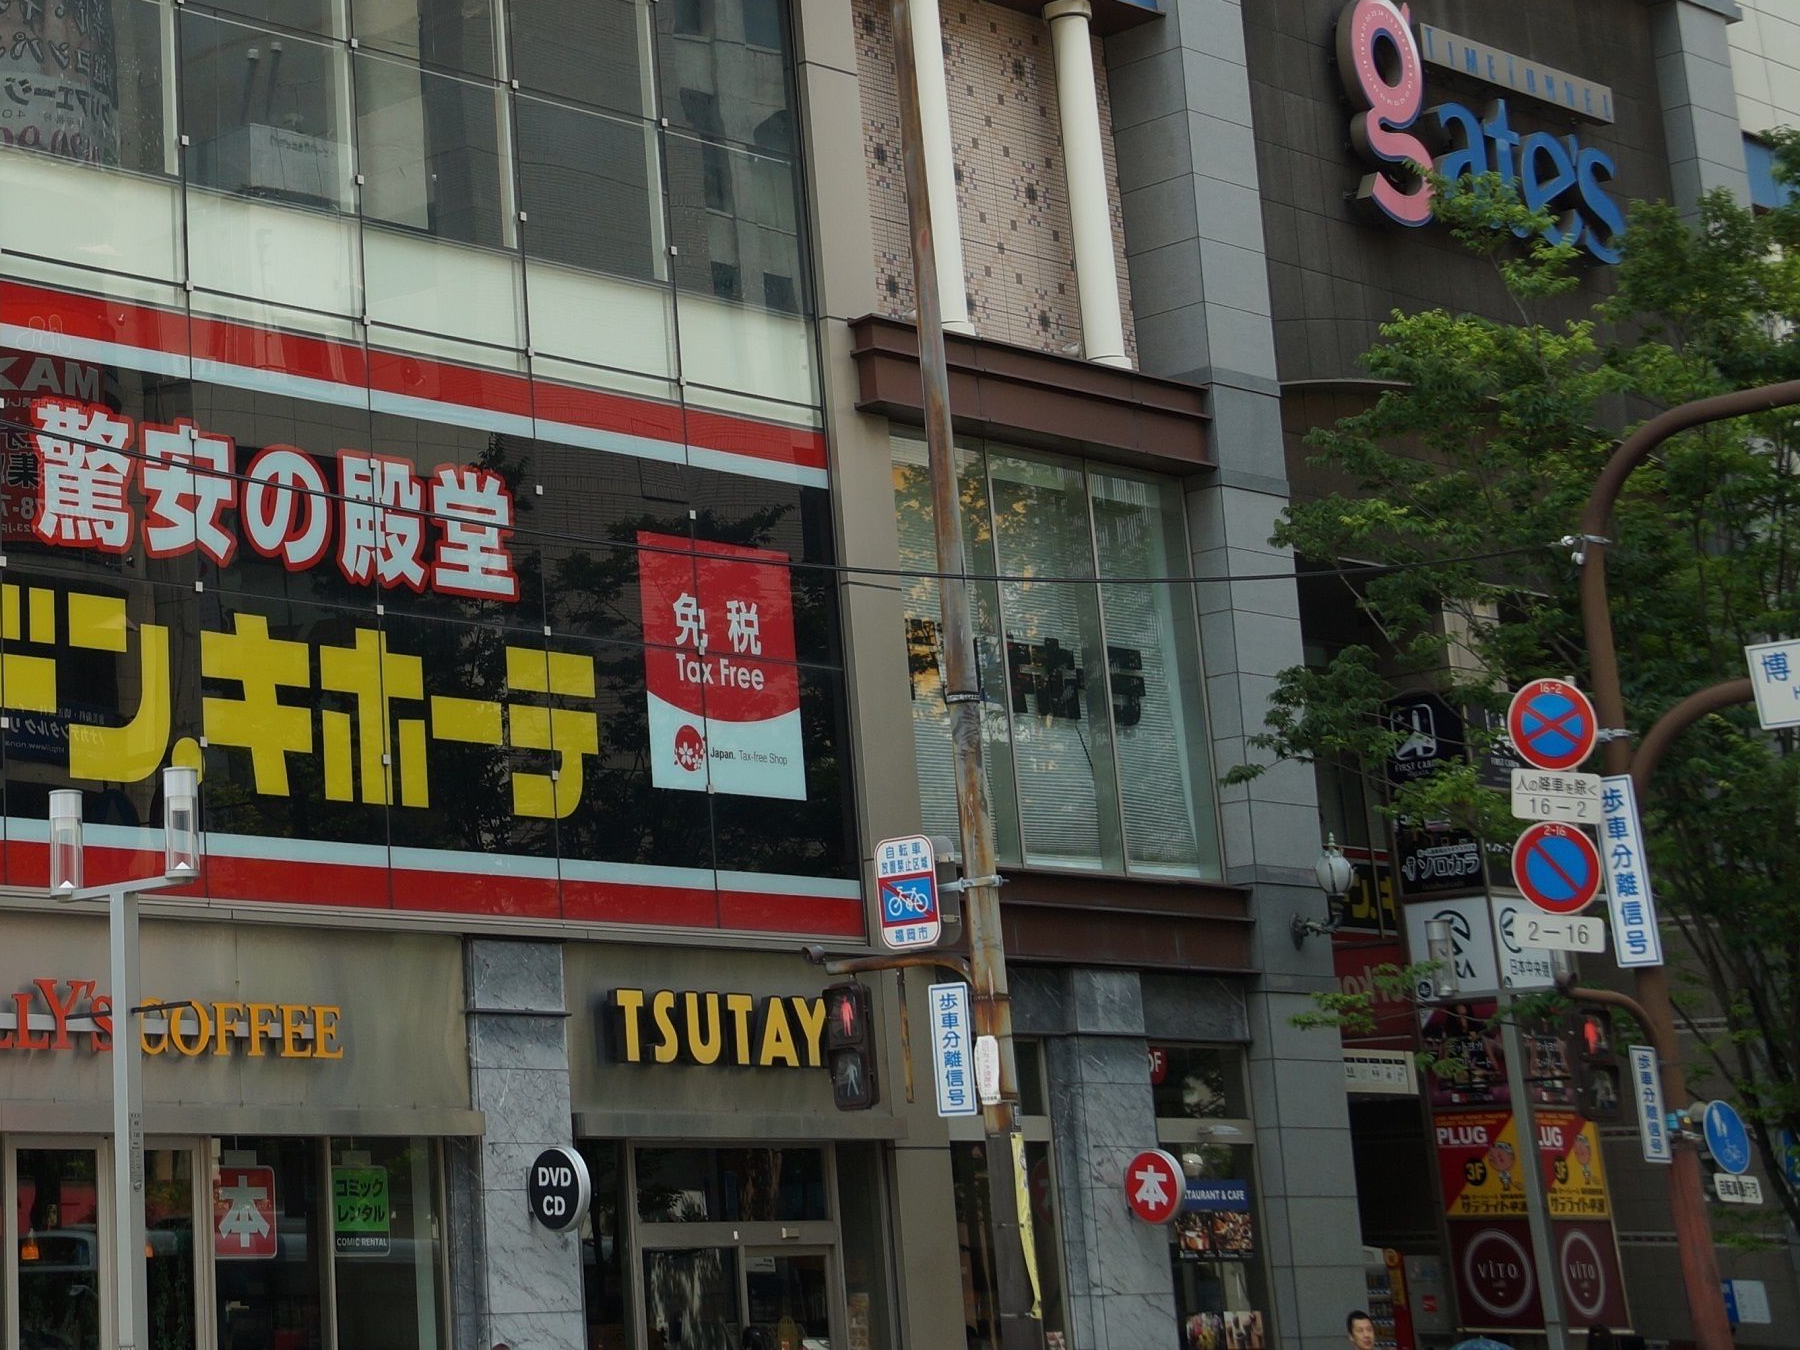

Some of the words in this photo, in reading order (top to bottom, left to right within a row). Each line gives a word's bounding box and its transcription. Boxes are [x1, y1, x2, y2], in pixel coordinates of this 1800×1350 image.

[33, 402, 518, 598] 驚安の殿堂
[671, 591, 762, 657] 免税
[675, 652, 714, 686] Tax
[719, 657, 765, 691] Free
[1539, 682, 1563, 694] 16-2
[769, 751, 788, 766] Shop
[1515, 776, 1598, 797] 人の降車を除く
[1543, 824, 1567, 838] 2-16
[885, 841, 921, 860] 自転車
[881, 856, 929, 875] 放置禁止区域
[1602, 787, 1649, 956] 歩車分離信号
[894, 926, 928, 943] 福岡市
[139, 997, 345, 1060] COFFEE
[615, 988, 827, 1068] TSUTAY
[939, 992, 966, 1107] 歩車分離信号
[1636, 1053, 1664, 1156] 歩車分離信号
[1436, 1125, 1488, 1146] PLUG
[538, 1165, 572, 1188] DVD
[1464, 1161, 1486, 1181] 3F
[335, 1178, 384, 1198] コミック
[1134, 1164, 1169, 1211] 本
[1227, 1189, 1246, 1201] CAFE
[218, 1175, 271, 1248] 本
[337, 1204, 386, 1223] レンタル
[542, 1194, 566, 1217] CD
[336, 1237, 360, 1247] COMIC
[361, 1236, 387, 1247] RENTAL
